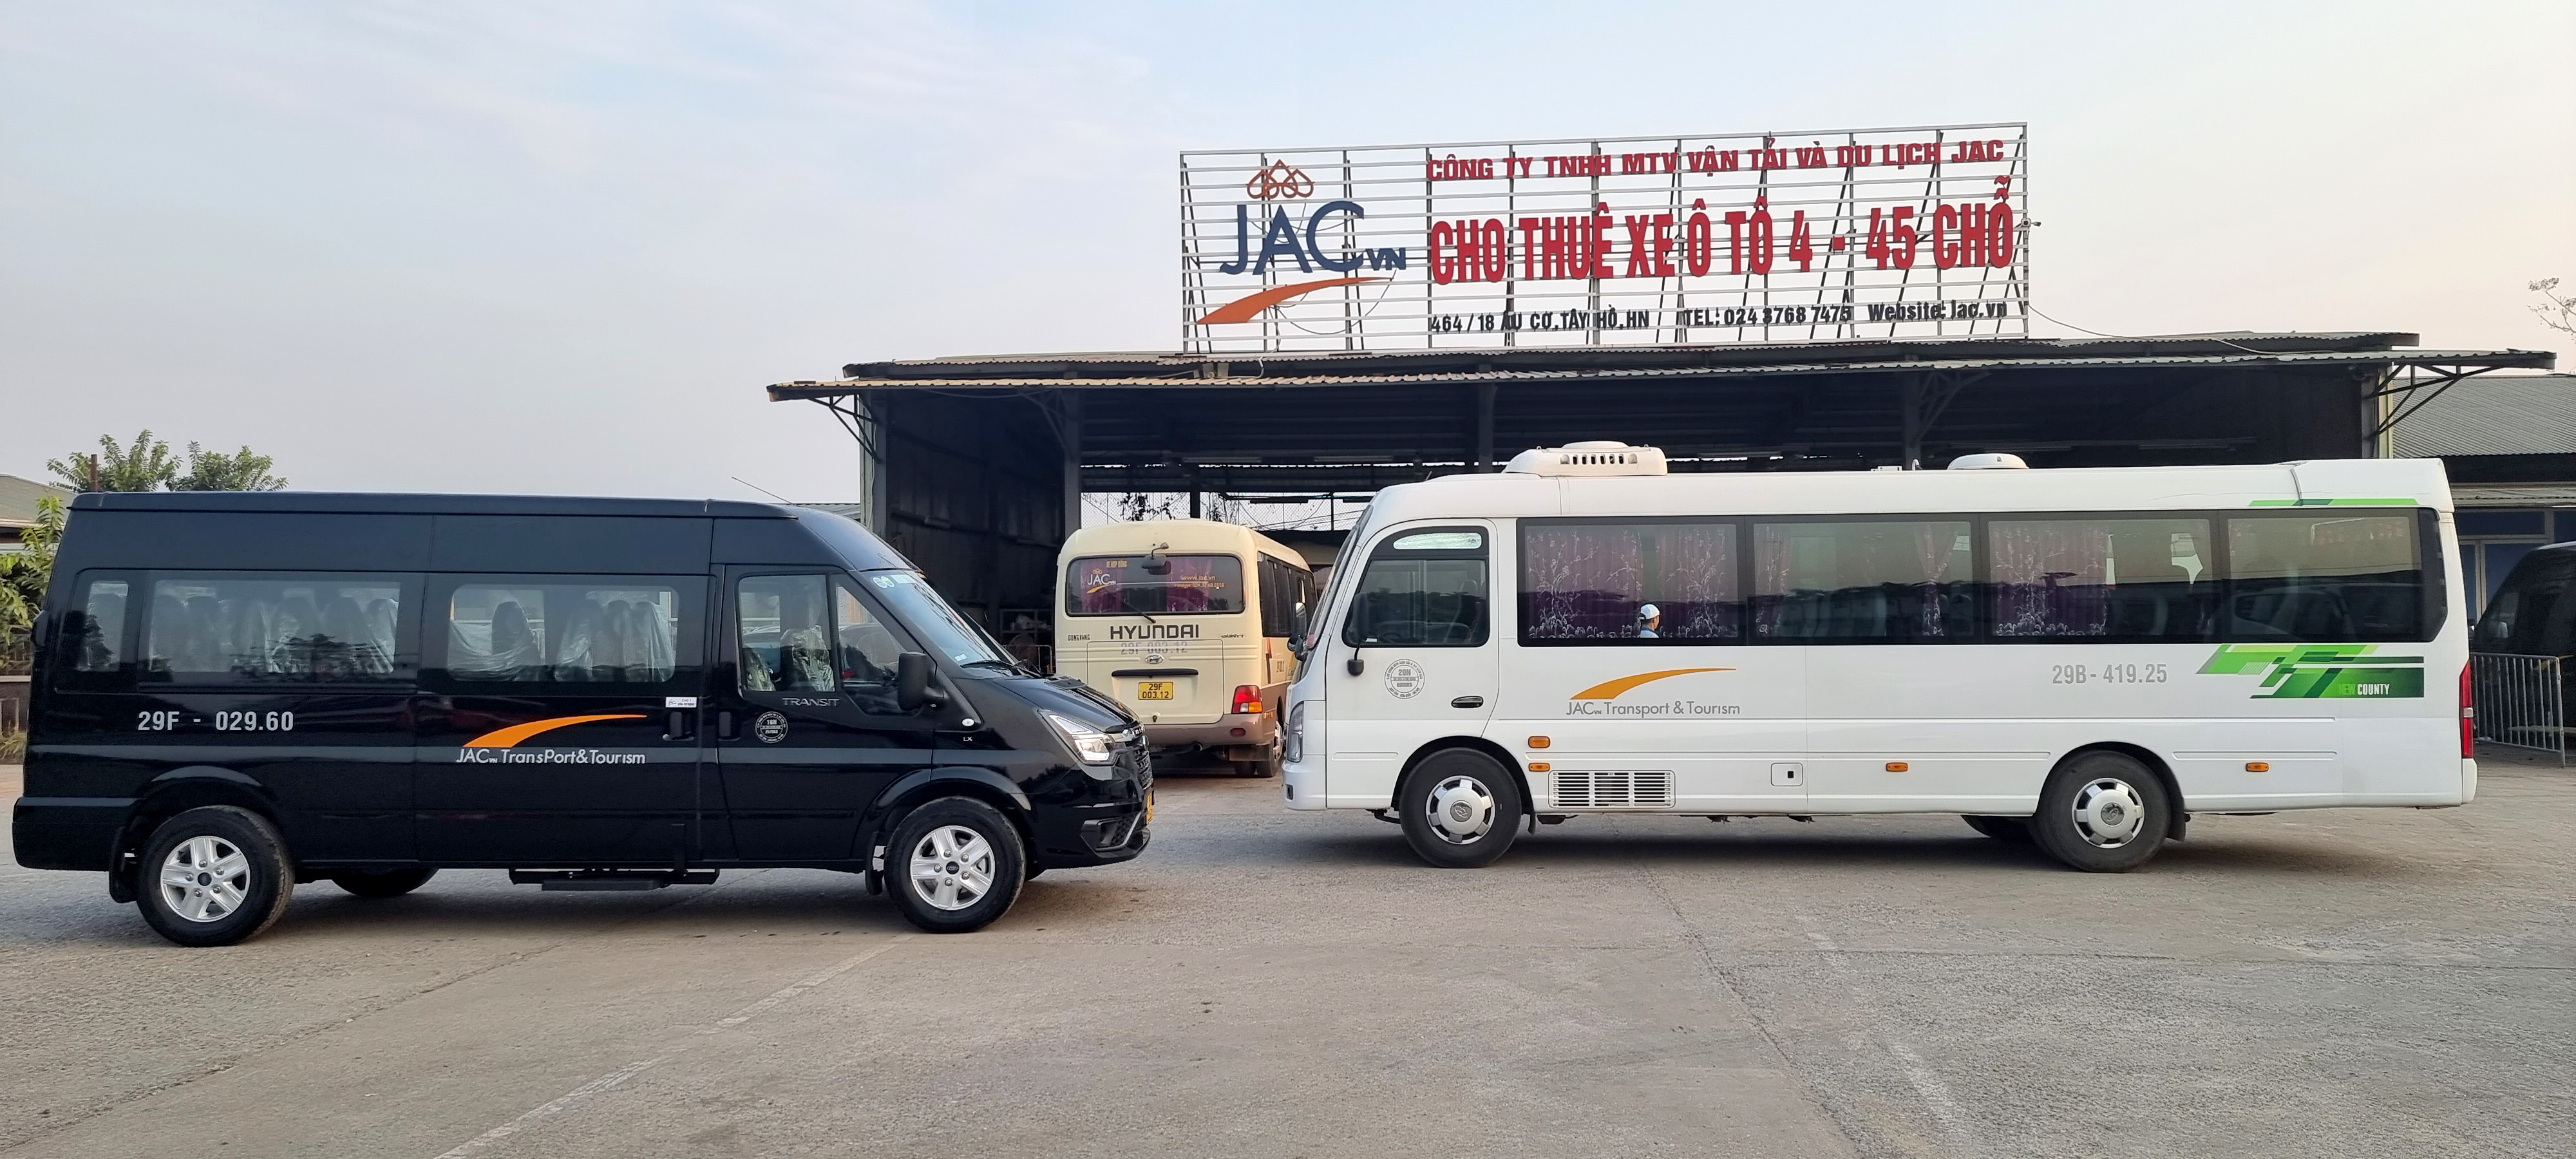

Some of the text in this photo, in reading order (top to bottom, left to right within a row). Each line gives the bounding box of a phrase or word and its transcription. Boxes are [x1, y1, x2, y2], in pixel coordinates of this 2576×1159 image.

[1427, 137, 2003, 181] CÔNG TY TNHH MTV VẬN TẢI VÀ DU LỊCH JAC
[1431, 218, 1505, 285] CHO
[1519, 202, 1614, 280] THUÊ
[1625, 213, 1675, 278] XE
[1687, 198, 1711, 277] Ô
[1725, 196, 1773, 275] TÔ
[1789, 210, 1813, 272] 4
[1866, 205, 1916, 270] 45
[1933, 175, 2014, 270] CHỖ
[1683, 308, 1719, 326] TEL:
[1724, 306, 1757, 325] 024
[1763, 305, 1806, 325] 3768
[1811, 304, 1852, 323] 7475
[1110, 625, 1199, 639] HYUNDAI
[2357, 684, 2390, 695] COUNTY
[782, 697, 840, 707] TRANSIT
[1604, 701, 1669, 718] Transport
[1674, 701, 1684, 715] &
[1686, 701, 1740, 715] Tourism
[137, 711, 180, 731] 29F
[216, 711, 294, 731] 029.60
